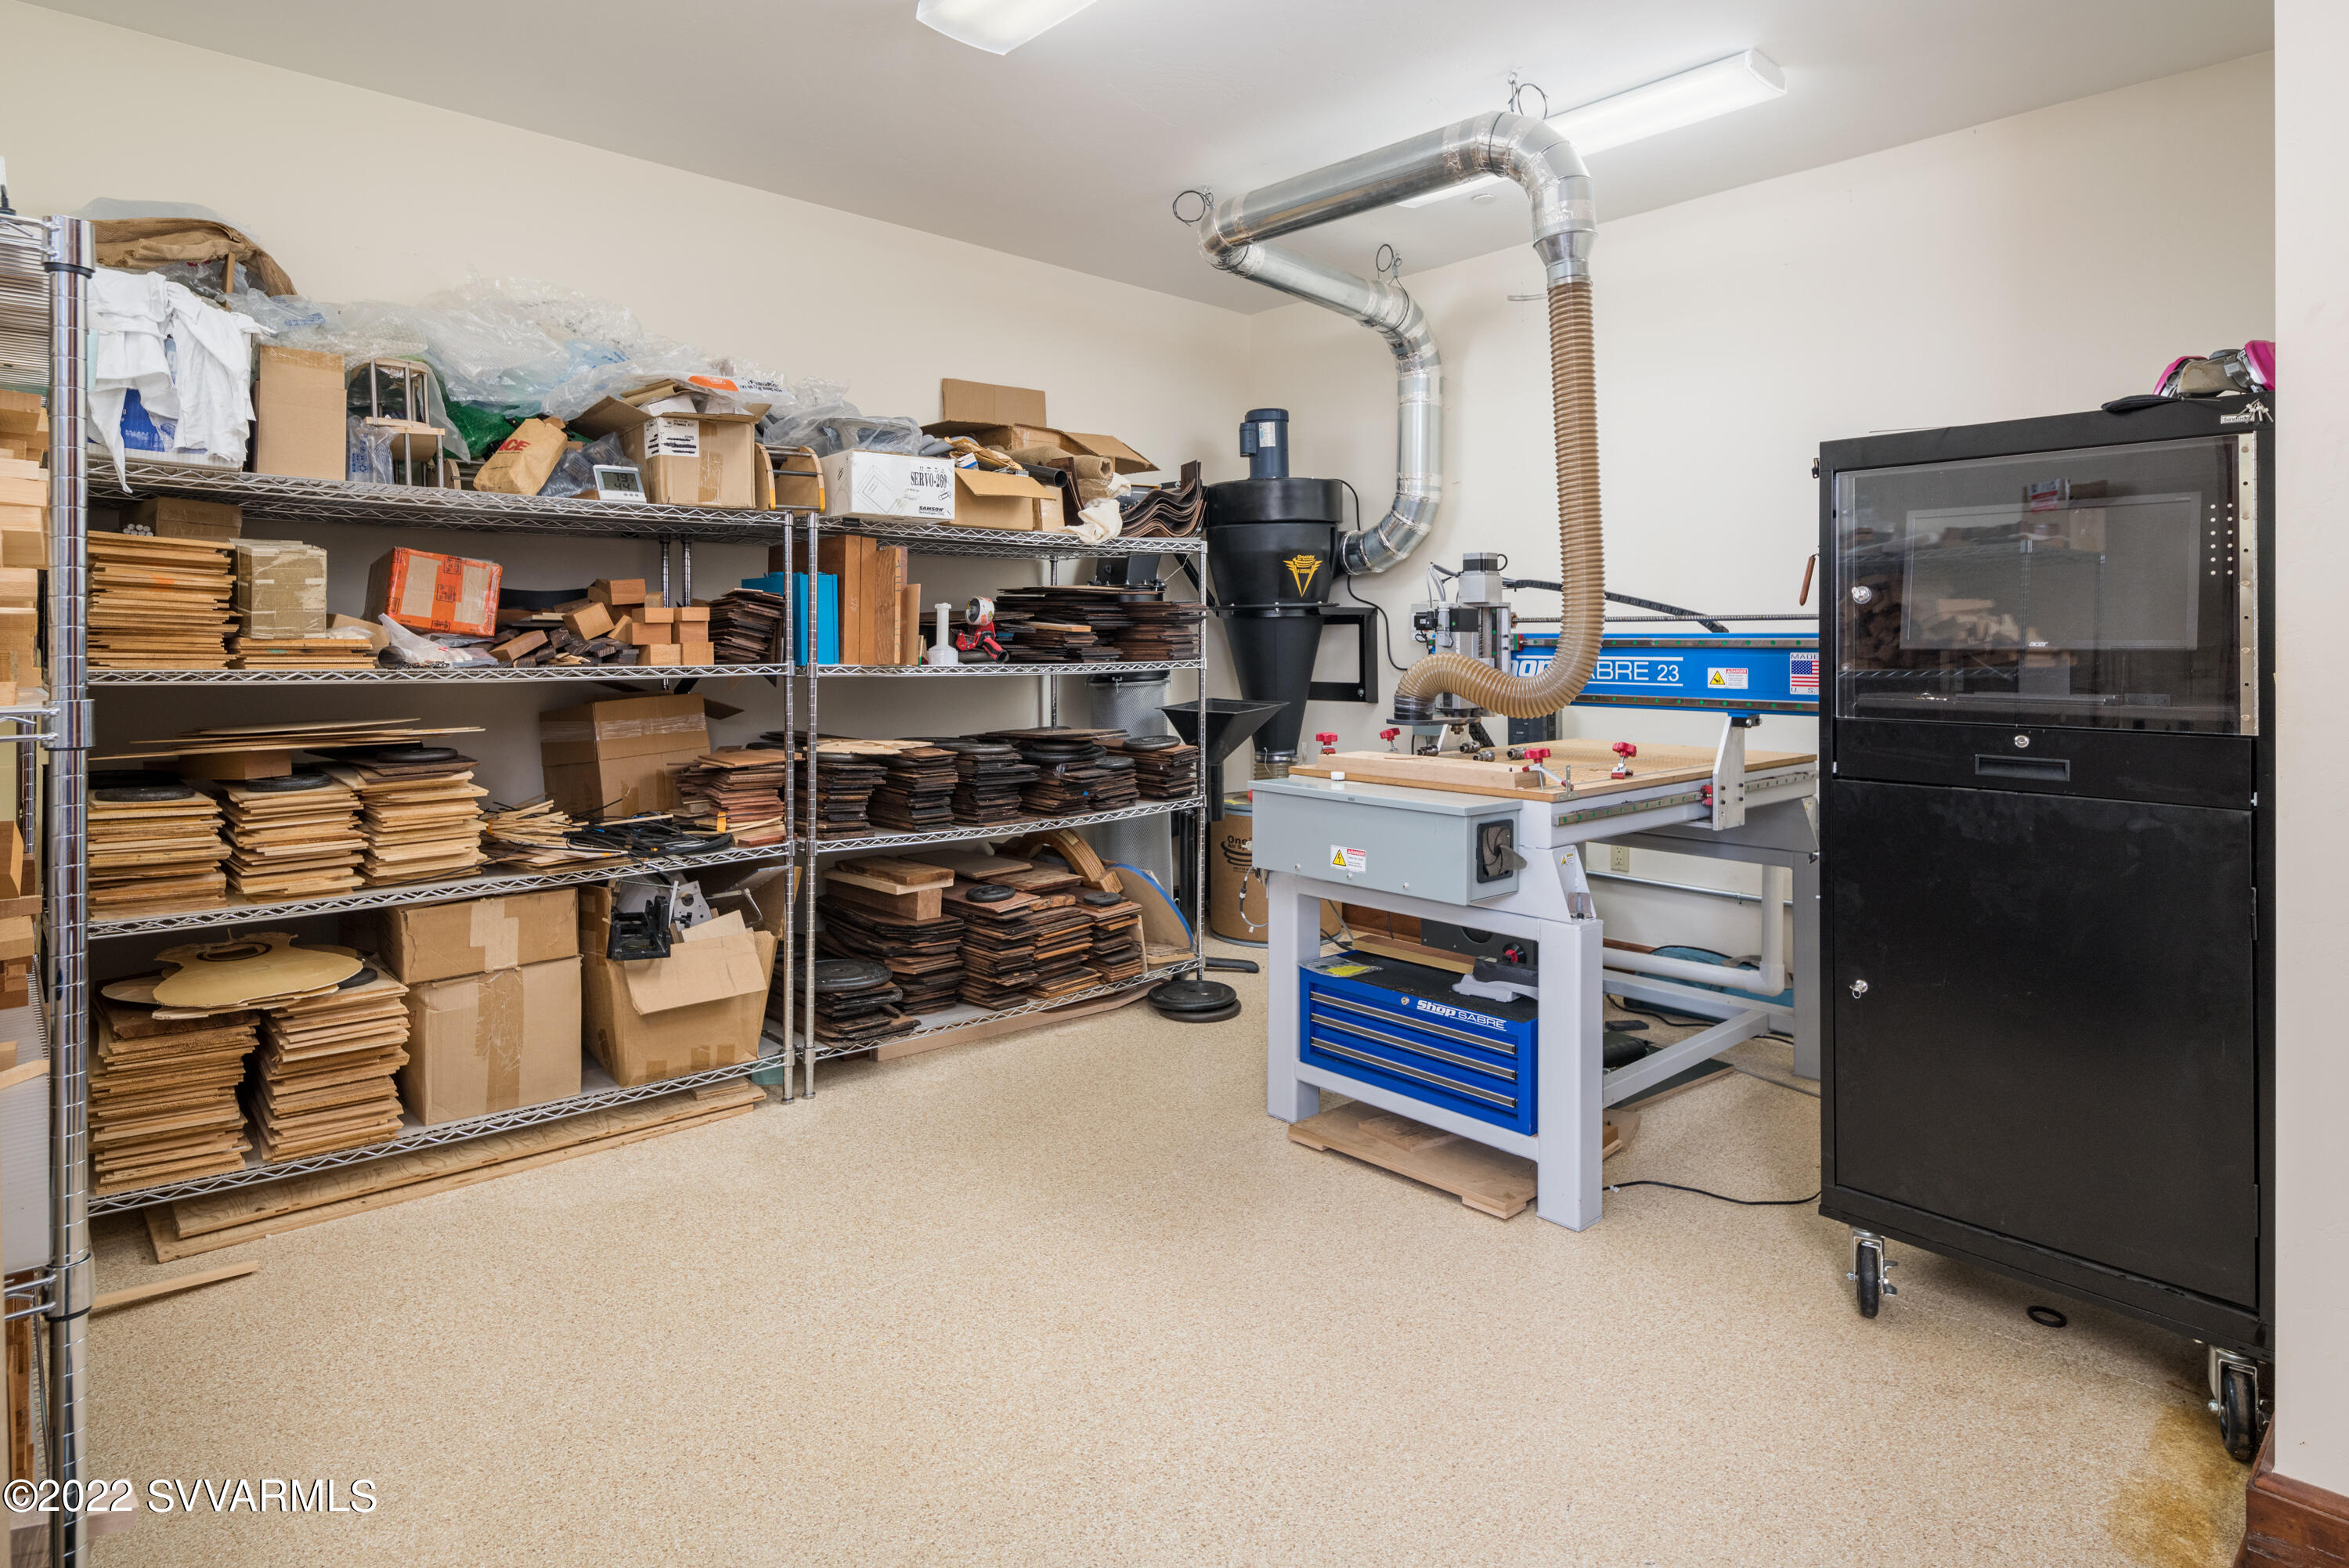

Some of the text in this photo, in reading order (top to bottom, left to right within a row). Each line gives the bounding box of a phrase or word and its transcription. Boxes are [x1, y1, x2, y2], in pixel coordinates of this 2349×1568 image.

[911, 471, 947, 488] SERVO-260
[1591, 661, 1649, 680] BRE
[1657, 665, 1680, 681] 23
[1416, 1000, 1505, 1029] Shop SABRE
